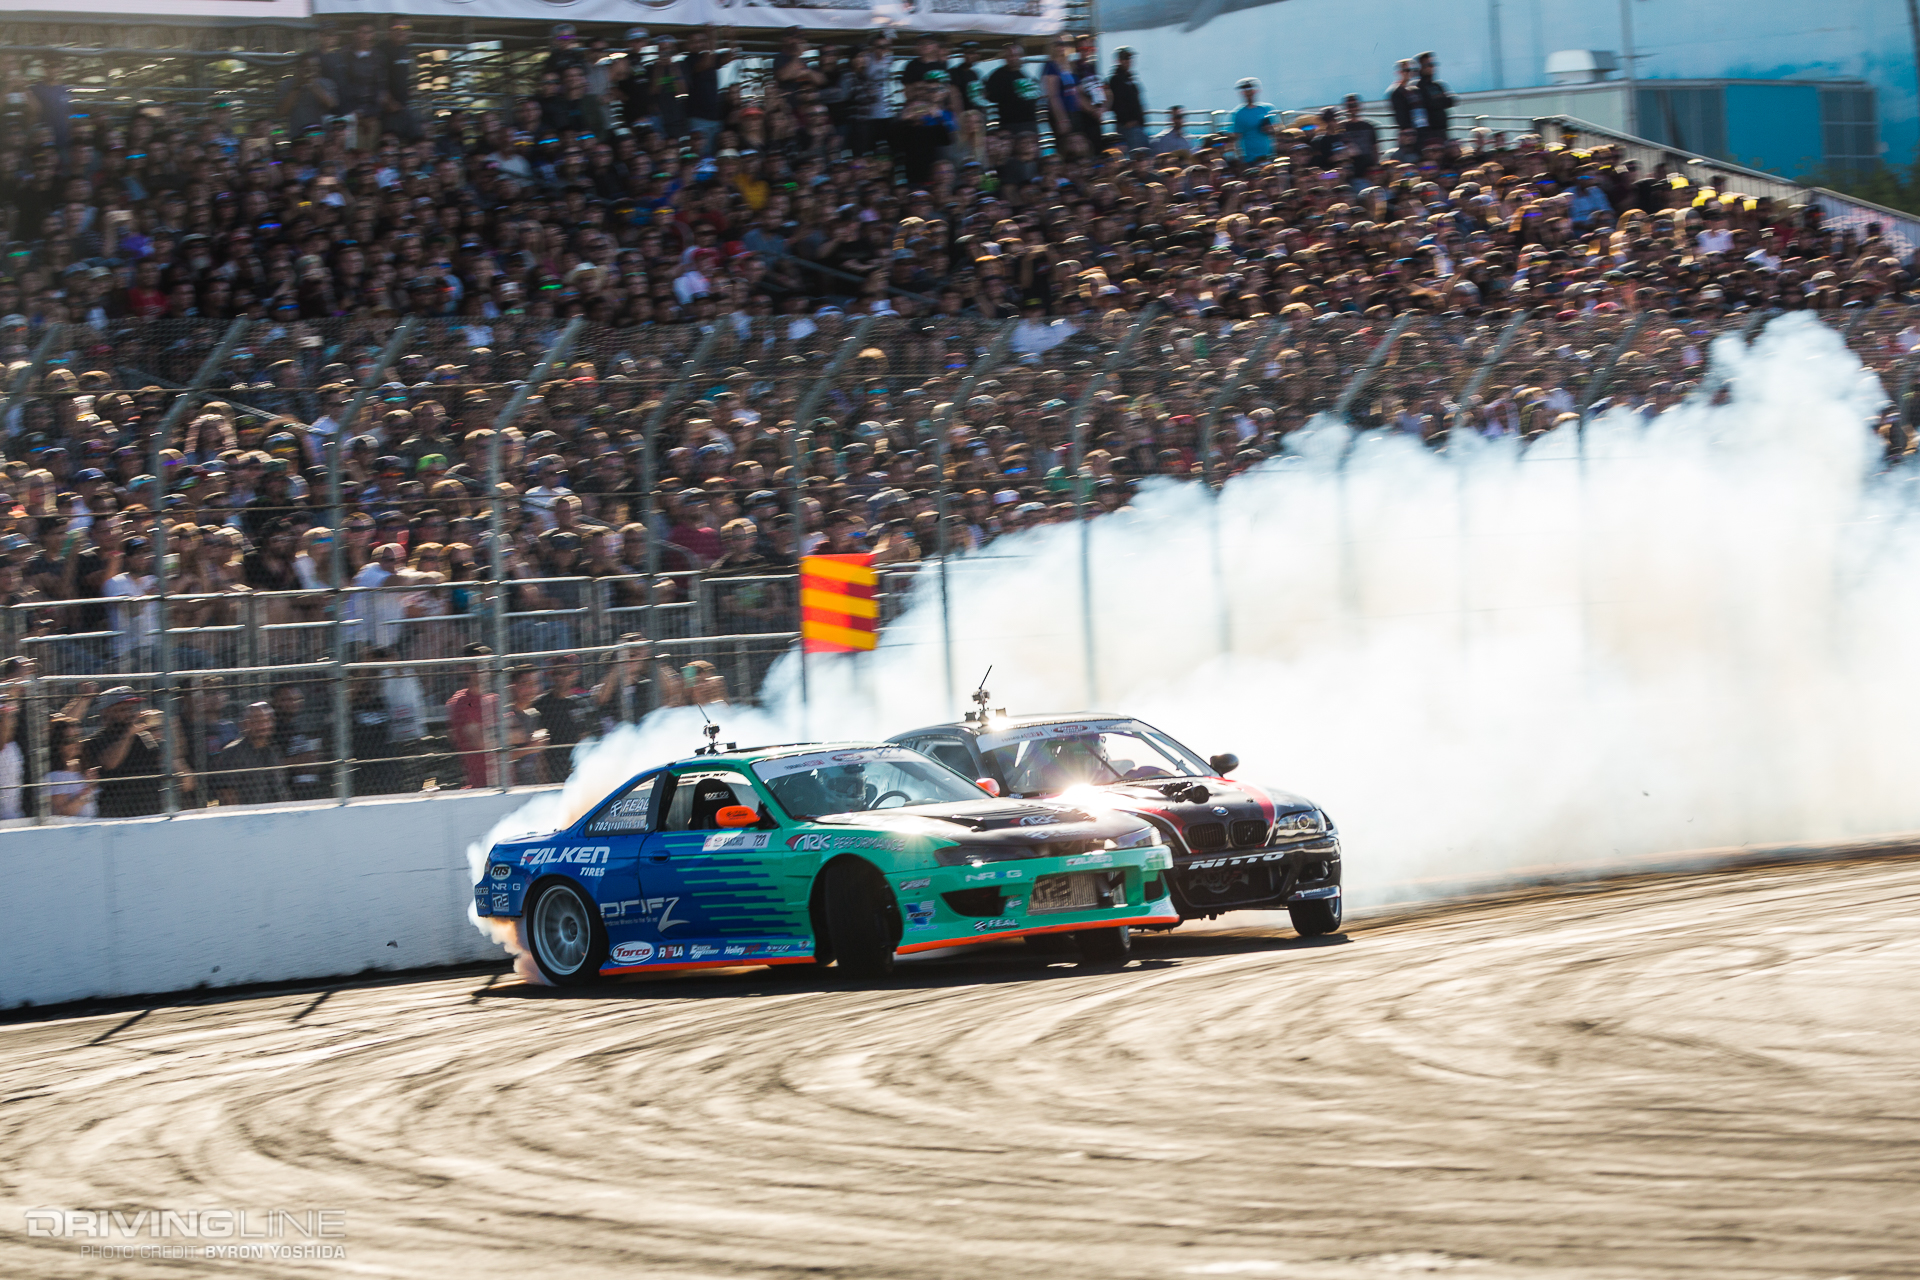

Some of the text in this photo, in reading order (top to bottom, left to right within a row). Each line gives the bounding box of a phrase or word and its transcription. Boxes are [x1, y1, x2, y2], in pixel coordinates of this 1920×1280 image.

[622, 797, 649, 812] FEAL
[753, 834, 767, 847] 723
[793, 833, 905, 851] ARK PERFORMANCE
[520, 846, 610, 866] FALKEN
[1188, 852, 1285, 870] NITTO
[580, 867, 605, 877] TIRES
[988, 919, 1018, 927] FEAL
[616, 946, 651, 957] Torco
[723, 945, 746, 956] Holley
